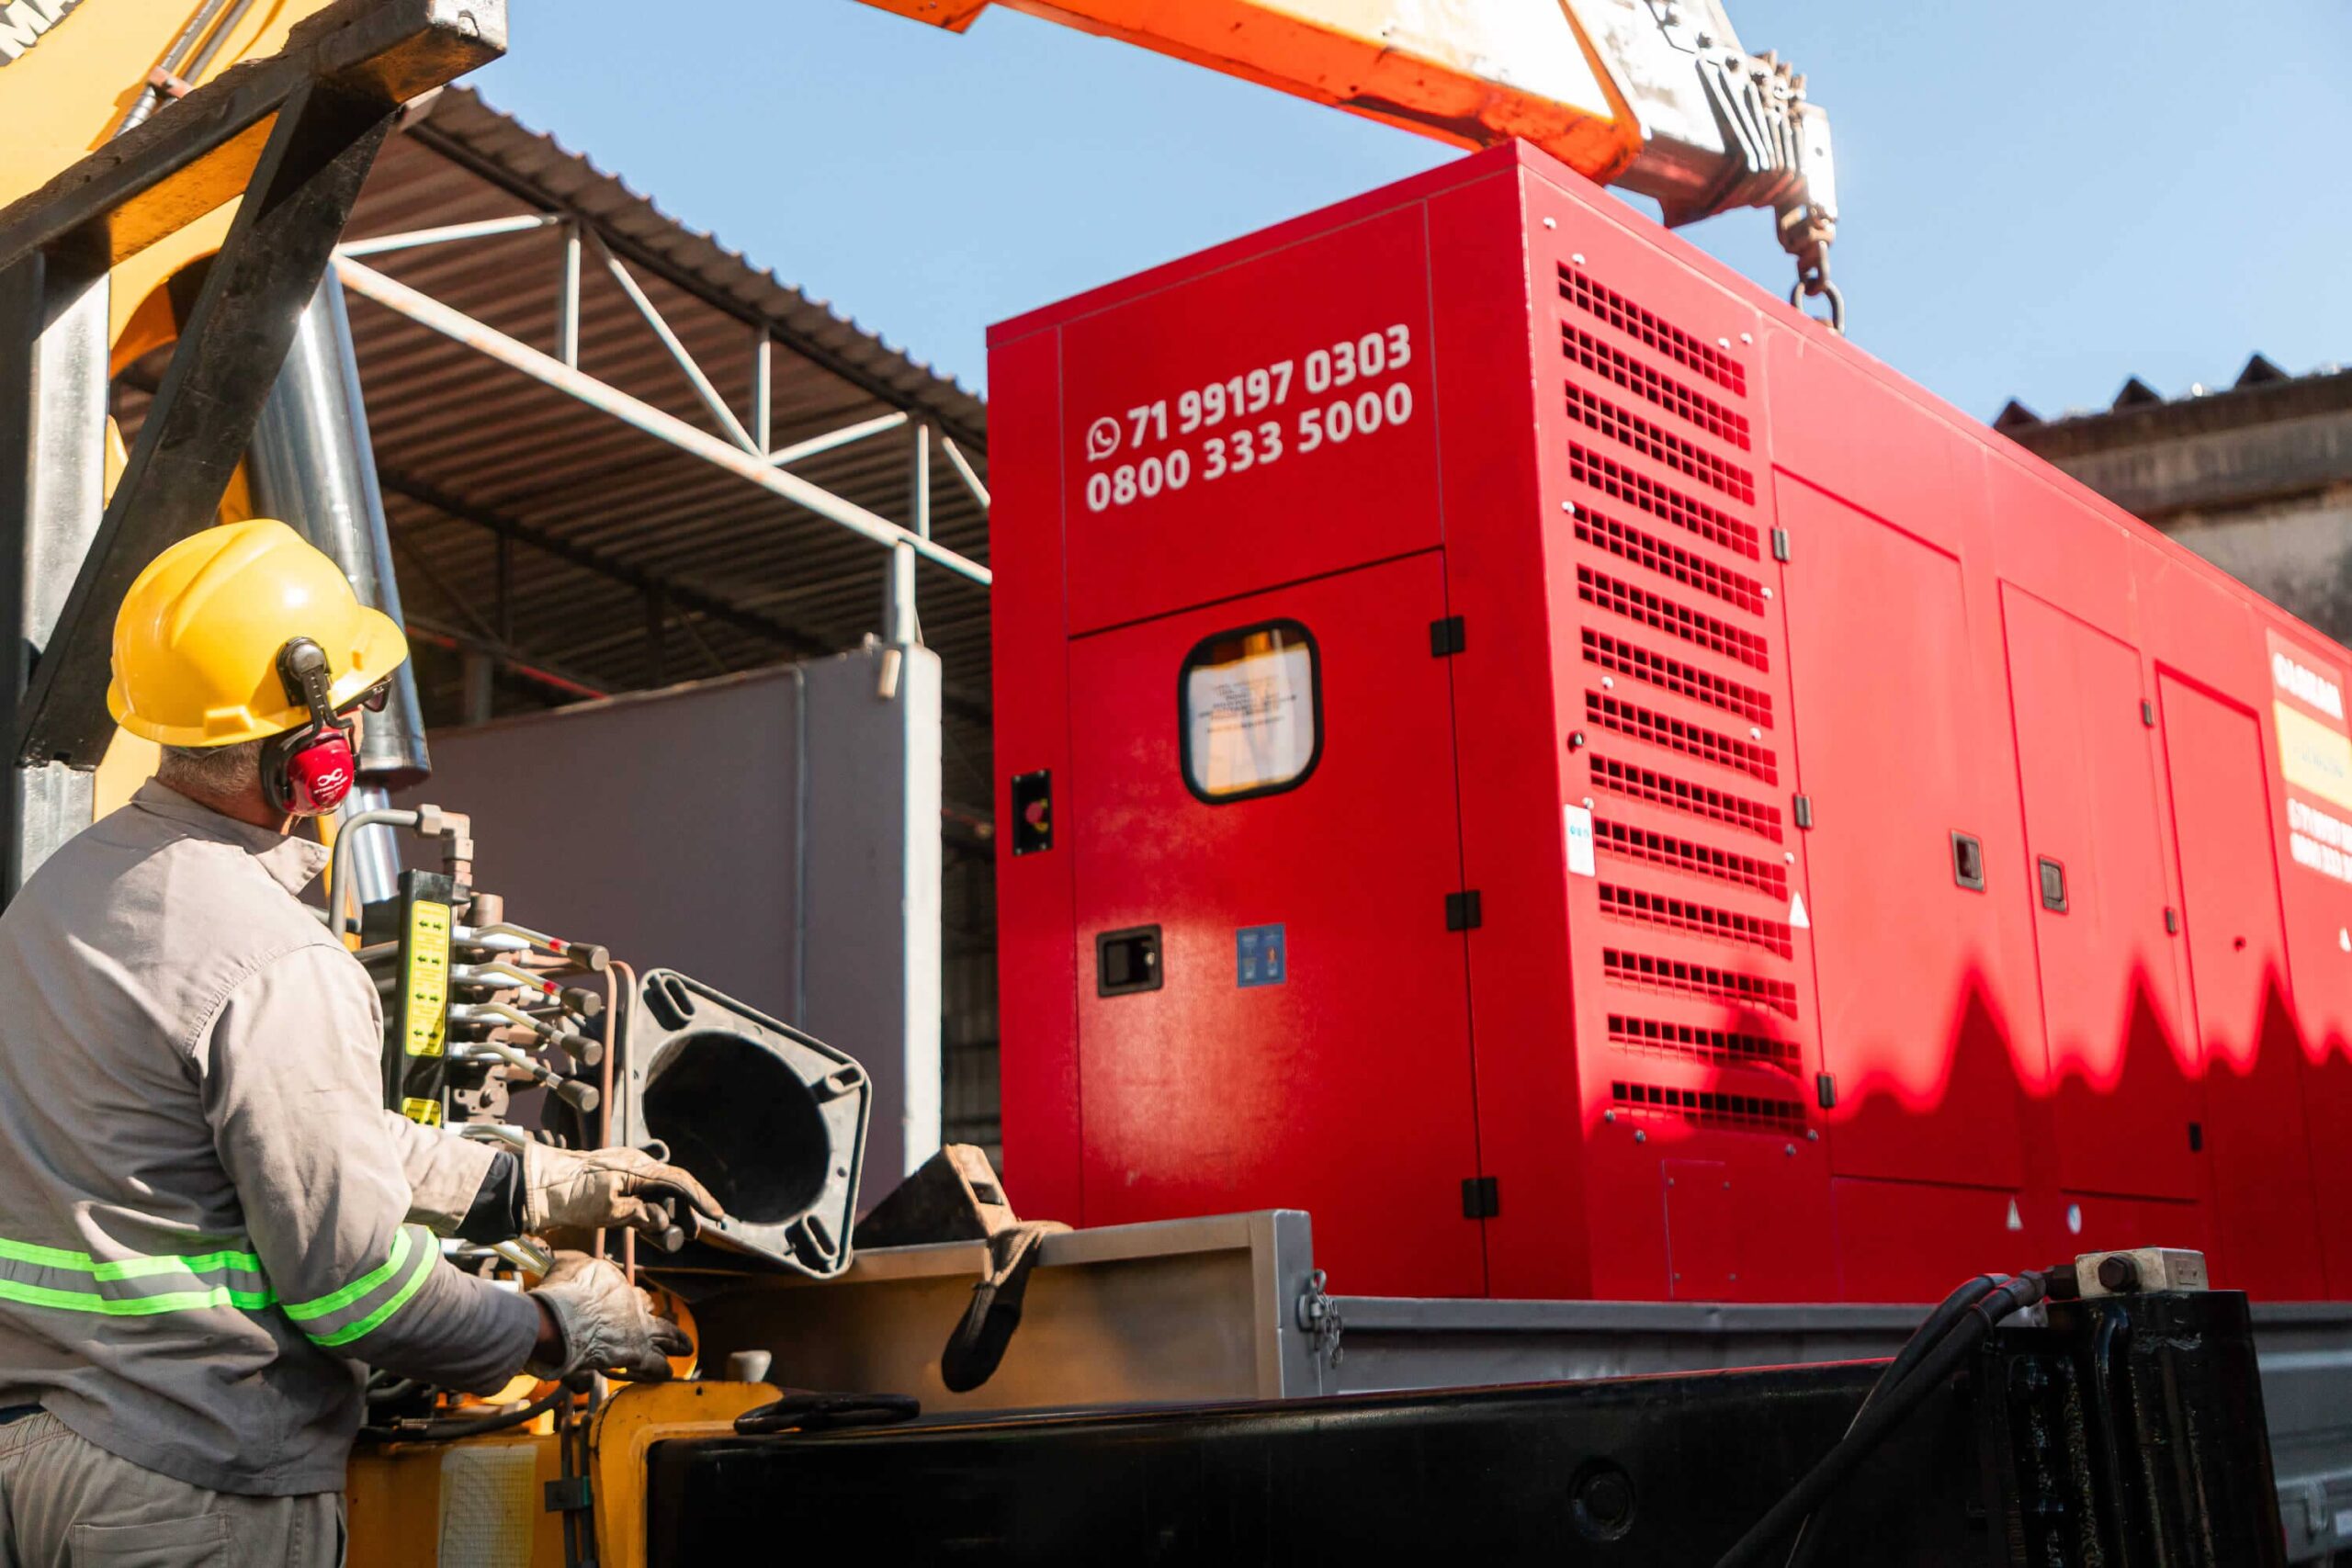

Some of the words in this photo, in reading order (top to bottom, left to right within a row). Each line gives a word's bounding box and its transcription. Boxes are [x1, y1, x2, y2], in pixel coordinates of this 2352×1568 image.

[1087, 449, 1191, 512] 0800
[1204, 421, 1283, 479] 333
[1298, 382, 1413, 453] 5000
[1127, 400, 1168, 448] 71
[1179, 360, 1294, 434] 99197
[1305, 323, 1411, 393] 0303
